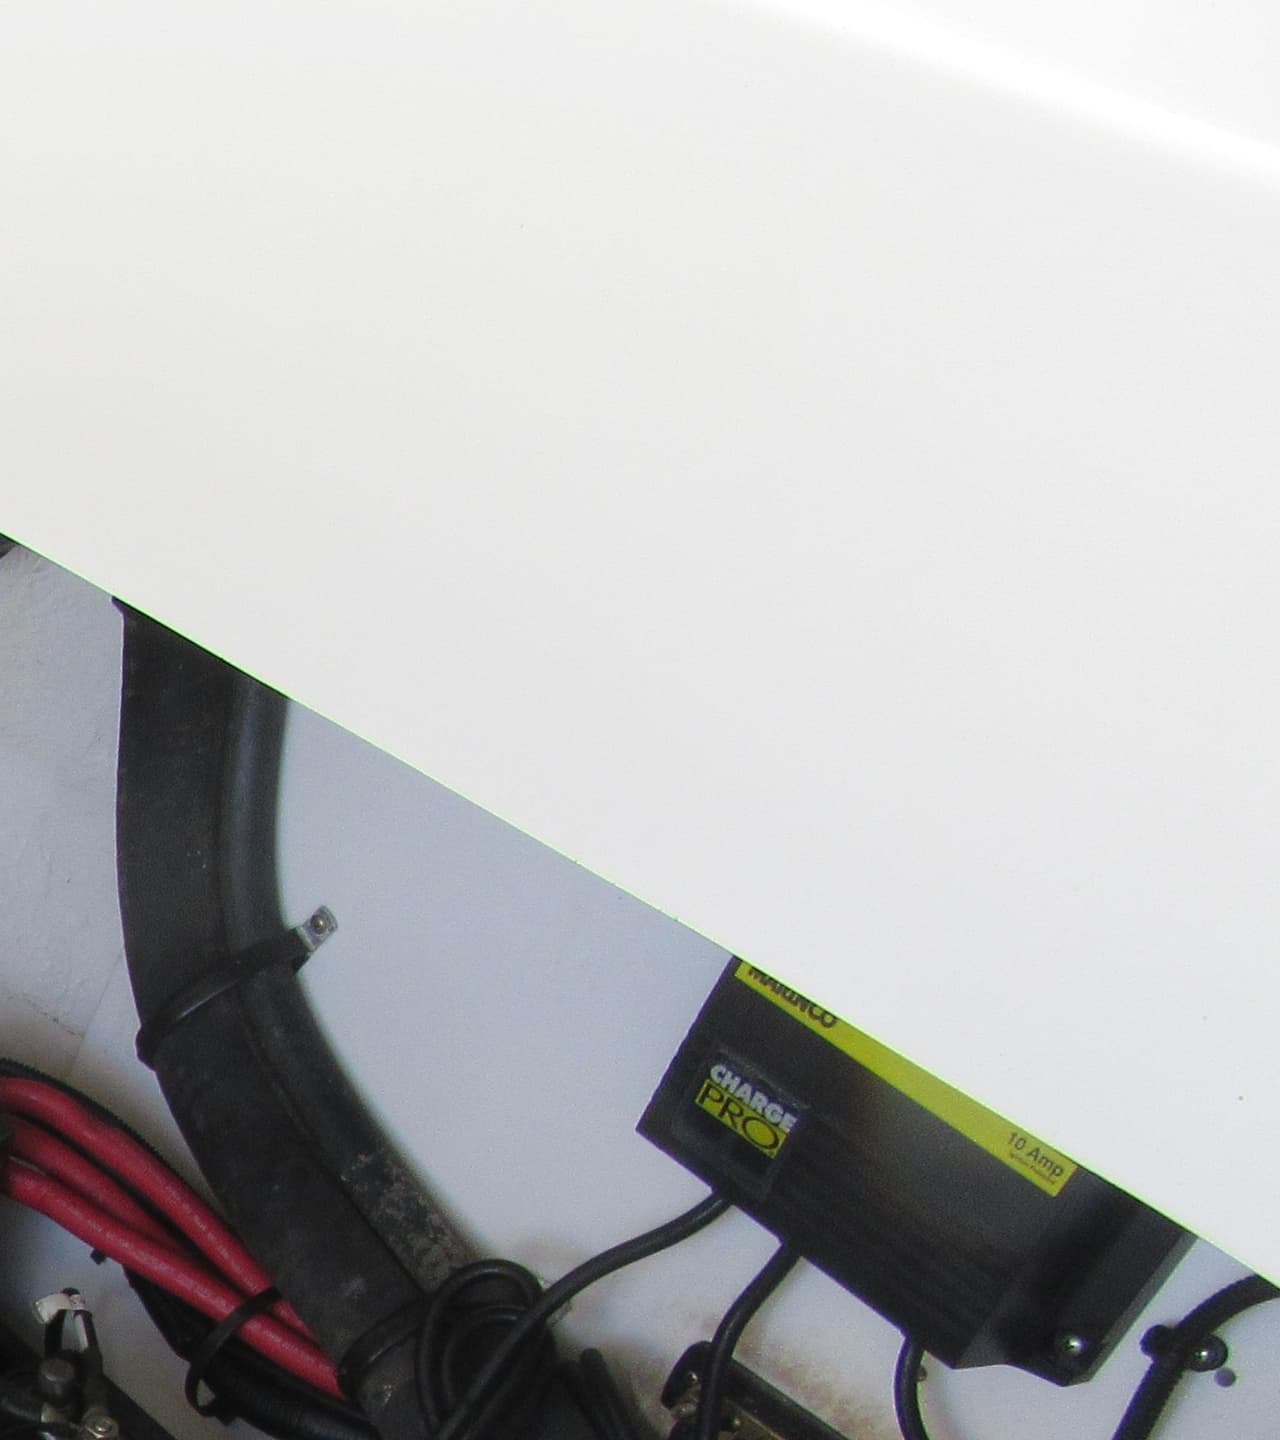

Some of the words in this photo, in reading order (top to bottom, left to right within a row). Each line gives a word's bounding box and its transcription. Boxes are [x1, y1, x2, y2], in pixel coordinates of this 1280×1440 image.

[698, 1084, 780, 1150] PRO
[710, 1064, 798, 1132] CHARGE
[1008, 1133, 1027, 1151] 10
[1027, 1148, 1064, 1177] Amp
